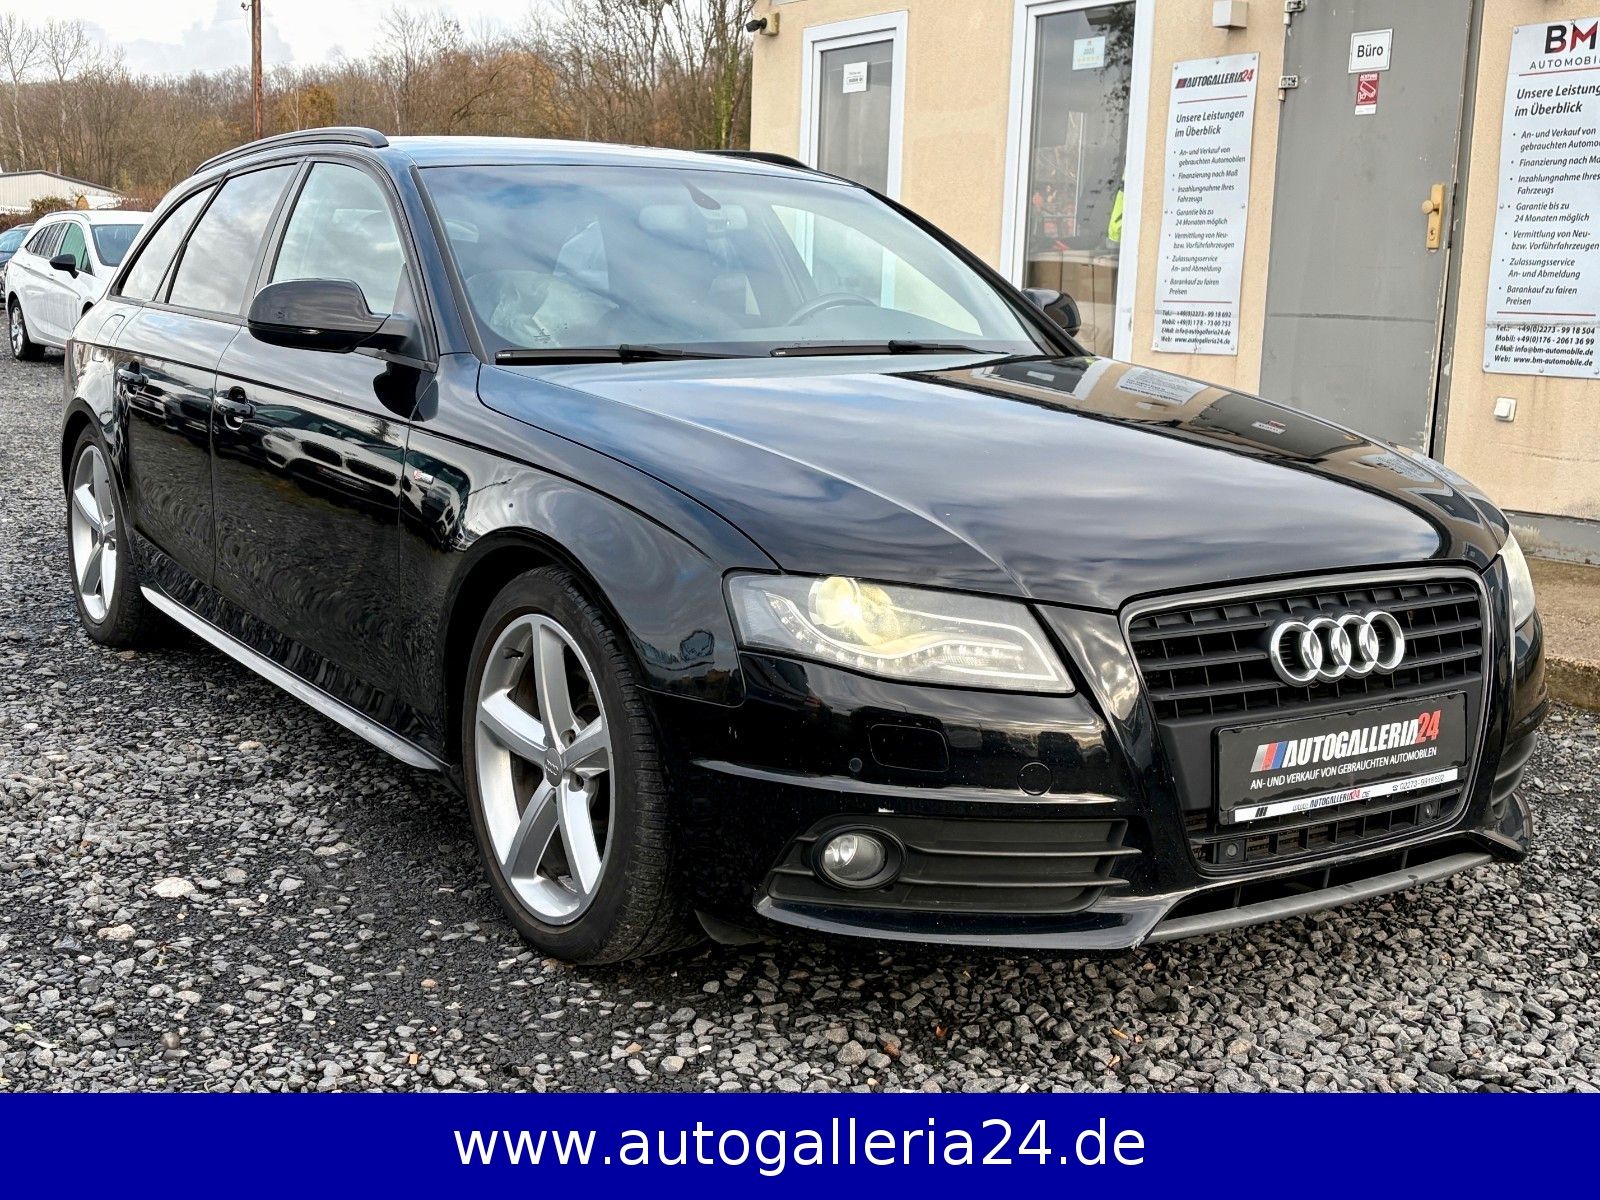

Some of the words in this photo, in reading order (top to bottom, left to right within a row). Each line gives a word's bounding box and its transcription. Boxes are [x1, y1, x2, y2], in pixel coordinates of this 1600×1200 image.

[1544, 21, 1599, 54] BM
[1357, 44, 1384, 58] Büro
[1529, 55, 1600, 70] AUTOMOBI
[1185, 69, 1255, 88] AUTOGALLERIA24
[1517, 87, 1553, 100] Unsere
[1515, 106, 1528, 117] im
[1530, 101, 1583, 116] Überblick
[1176, 113, 1201, 123] Unsere
[1202, 110, 1245, 122] Leistungen
[1175, 128, 1184, 137] im
[1186, 125, 1221, 137] Überblick
[1521, 131, 1534, 139] An-
[1535, 129, 1550, 138] und
[1552, 127, 1581, 137] Verkauf
[1582, 128, 1596, 136] von
[1520, 141, 1567, 153] gebrauchten
[1519, 156, 1567, 167] Finanzierung
[1569, 156, 1588, 165] nach
[1518, 173, 1581, 184] Inzahlungnahme
[1582, 172, 1600, 181] Ihres
[1517, 186, 1554, 196] Fahrzeugs
[1516, 202, 1547, 211] Garantie
[1549, 202, 1560, 210] bis
[1514, 214, 1524, 223] 24
[1525, 214, 1558, 223] Monaten
[1558, 213, 1590, 224] möglich
[1513, 230, 1556, 241] Vermittlung
[1572, 230, 1591, 238] Neu-
[1511, 242, 1528, 250] bzw.
[1529, 241, 1600, 252] Vorführfahrzeugen
[1509, 257, 1575, 268] Zulassungsservice
[1508, 270, 1521, 278] An-
[1522, 270, 1536, 278] und
[1537, 270, 1581, 280] Abmeldung
[1506, 285, 1545, 294] Barankauf
[1555, 286, 1578, 295] fairen
[1506, 297, 1532, 306] Preisen
[1518, 324, 1556, 334] +49(0)2273
[1581, 327, 1595, 335] 504
[1495, 335, 1515, 343] Mobil:
[1517, 335, 1551, 344] +49(0)176
[1556, 336, 1573, 345] 2061
[1575, 337, 1584, 345] 36
[1515, 346, 1594, 356] info@bm-automobile.de
[1494, 355, 1511, 363] Web:
[1513, 357, 1593, 367] www.bm-automobile.de
[1282, 709, 1442, 768] AUTOGALLERIA24
[1250, 779, 1266, 790] AN-
[1267, 775, 1286, 788] UND
[1286, 769, 1320, 784] VERKAUF
[1321, 766, 1337, 778] VON
[1337, 755, 1389, 775] GEBRAUCHTEN
[1389, 746, 1437, 765] AUTOMOBILEN
